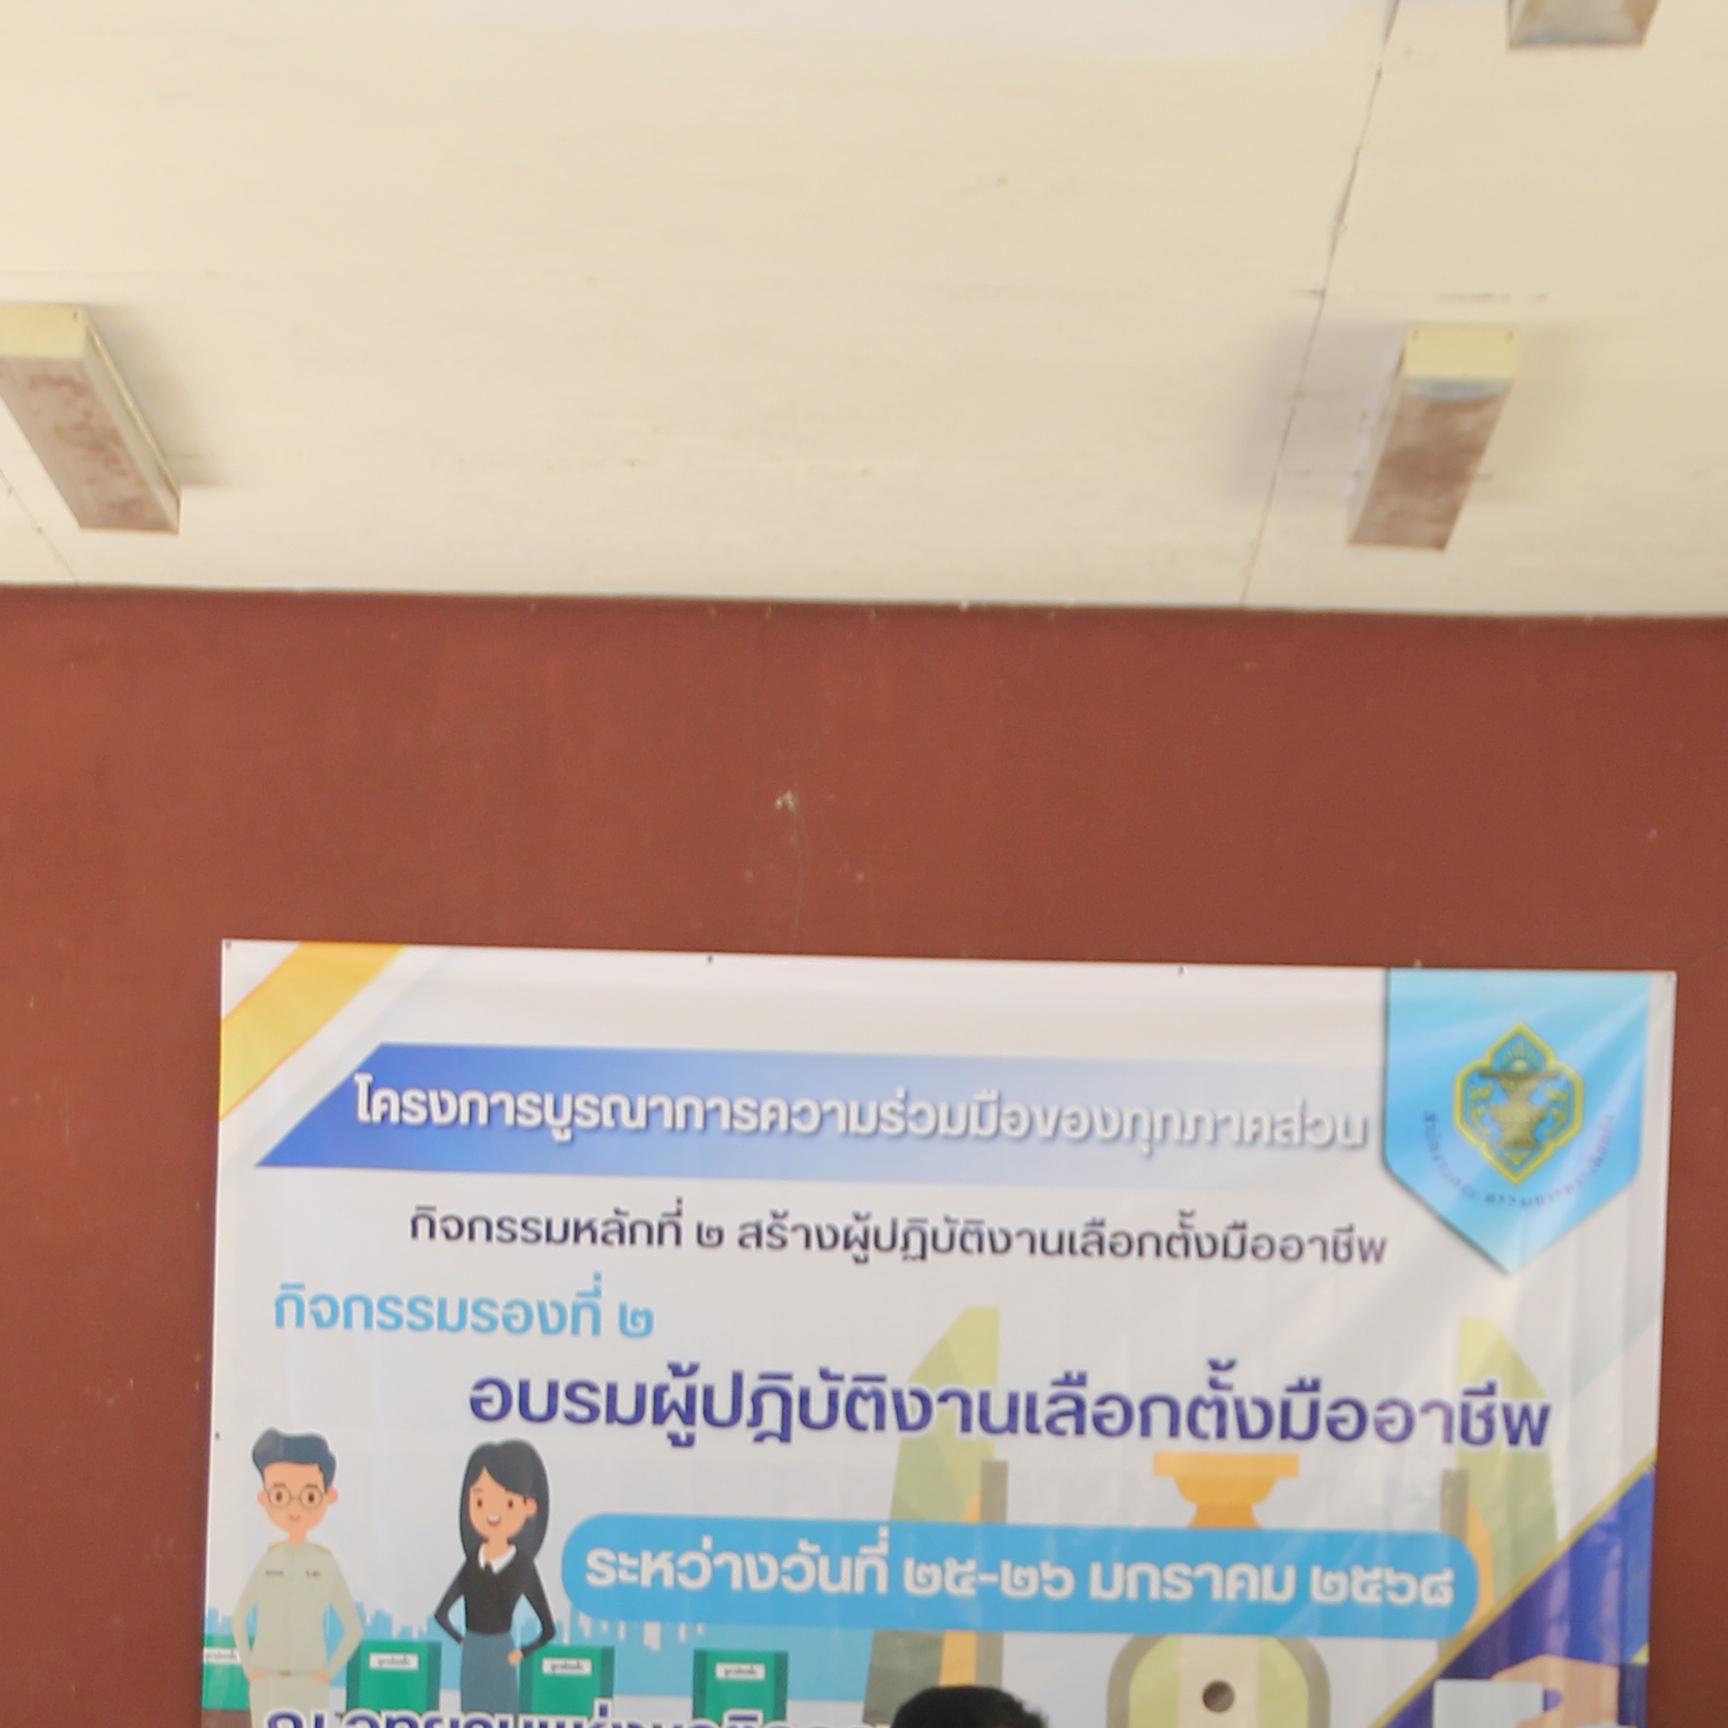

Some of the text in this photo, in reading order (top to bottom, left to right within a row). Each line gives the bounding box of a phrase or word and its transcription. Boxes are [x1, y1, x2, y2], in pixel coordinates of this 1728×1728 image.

[354, 1071, 1368, 1156] โครงการบูรณาการความร่วมมือของทุกภาคส่วน
[409, 1197, 1388, 1266] กิจกรรมหลักที่ ๒ สร้างผู้ปฏิบัติงานเลือกตั้งมืออาชีพ
[273, 1272, 655, 1338] กิจกรรมรองที่ ๒
[585, 1526, 890, 1594] ระหว่างวันที่
[1089, 1559, 1296, 1603] มกราคม
[1309, 1566, 1455, 1607] ๒๕๖๘
